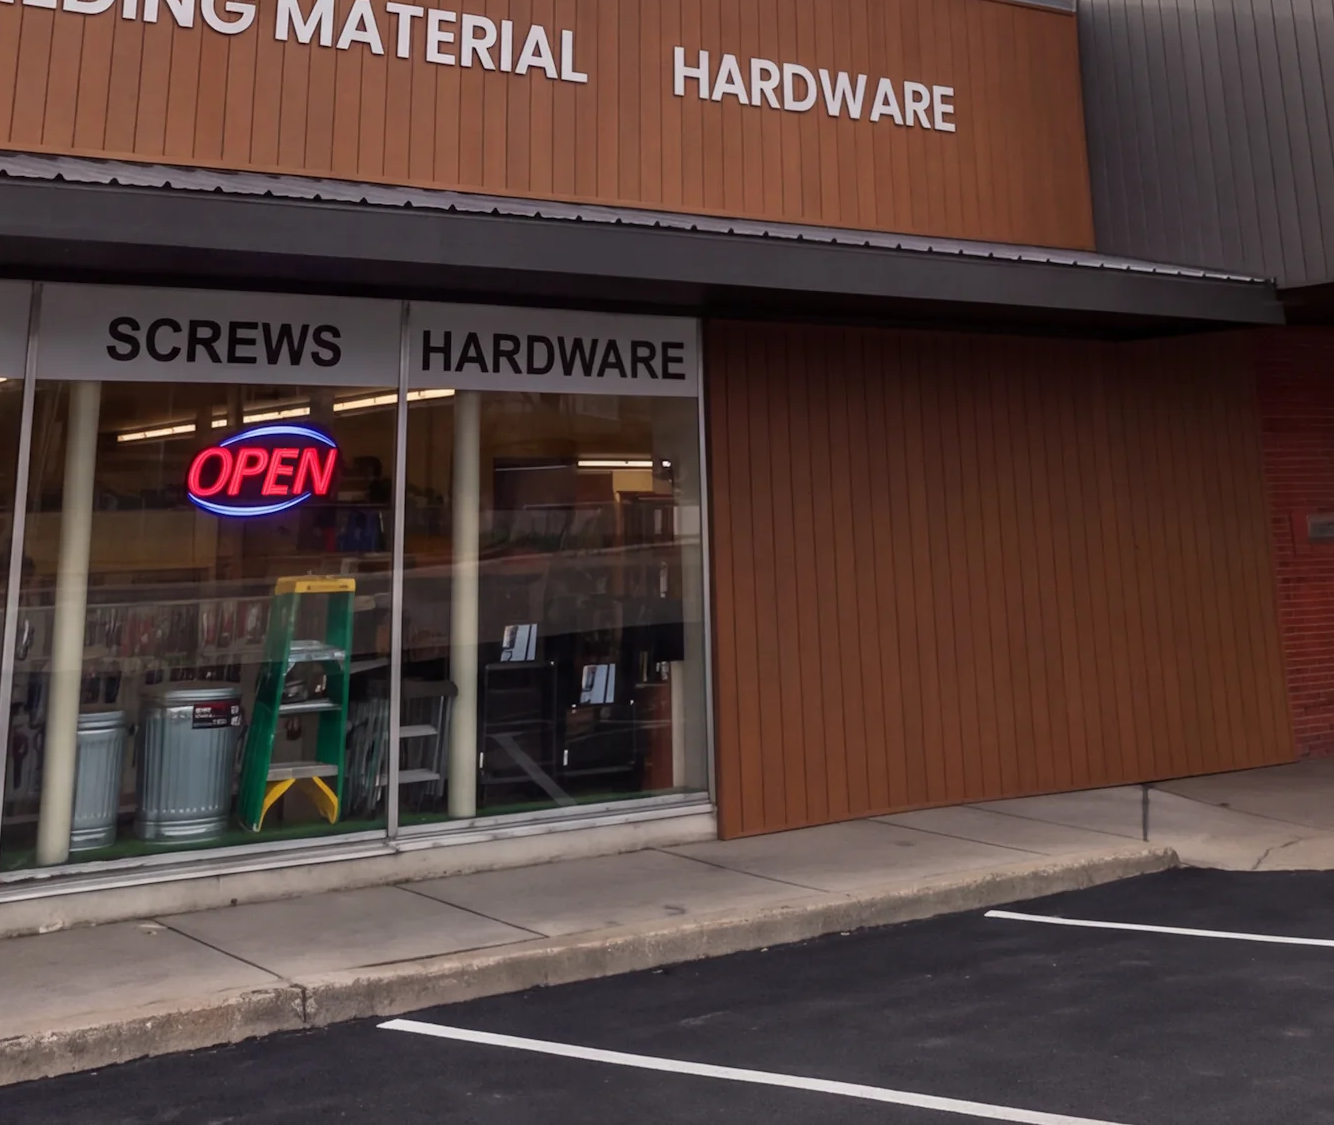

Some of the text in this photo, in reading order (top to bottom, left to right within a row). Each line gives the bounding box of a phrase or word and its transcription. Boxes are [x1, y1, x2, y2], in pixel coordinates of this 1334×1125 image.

[673, 46, 957, 133] HARDWARE
[106, 315, 342, 368] SCREWS
[421, 329, 686, 381] HARDWARE
[187, 446, 338, 497] OPEN
